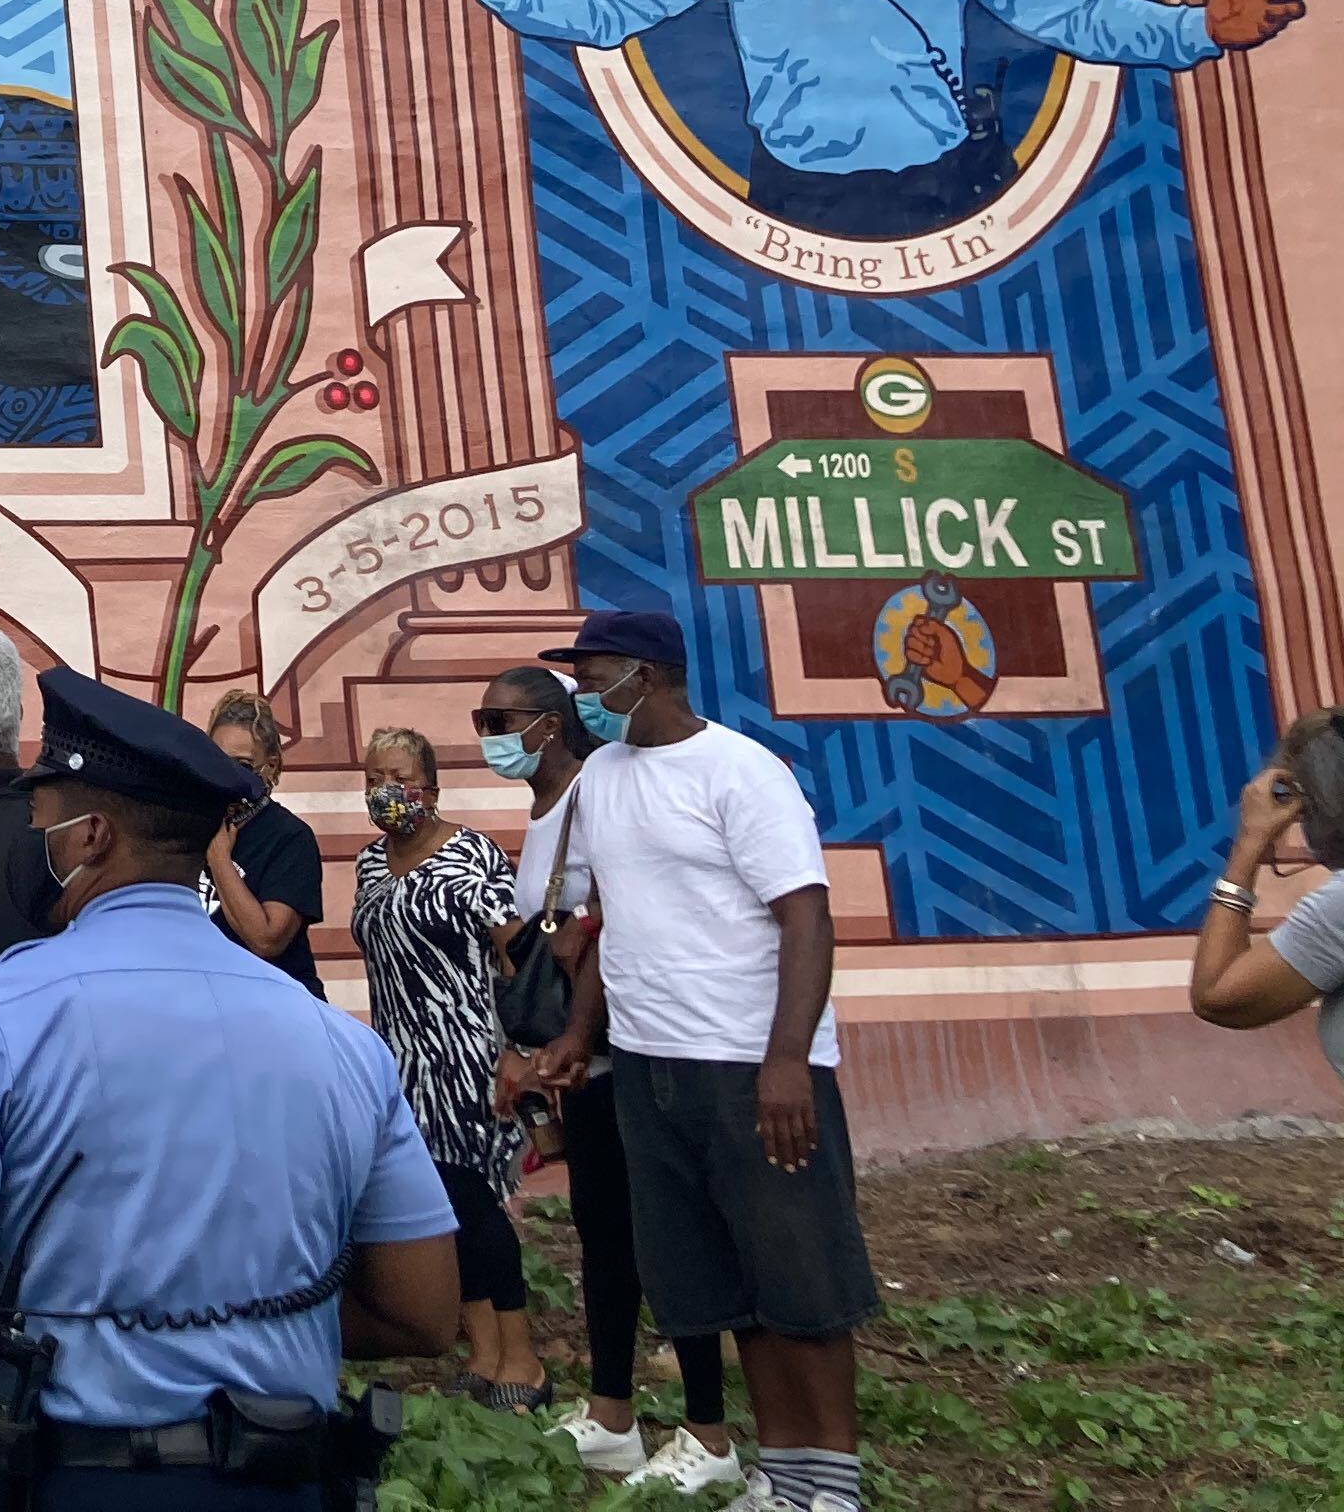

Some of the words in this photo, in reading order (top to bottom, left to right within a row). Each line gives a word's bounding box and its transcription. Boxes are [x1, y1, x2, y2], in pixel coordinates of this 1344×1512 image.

[744, 213, 884, 289] “Bring
[894, 245, 936, 281] It
[940, 213, 1000, 269] In”
[864, 373, 927, 417] G
[818, 452, 871, 480] 1200
[894, 447, 918, 483] S
[292, 483, 546, 613] 3-5-2015
[720, 494, 1029, 570] MILLICK
[1051, 519, 1107, 567] ST
